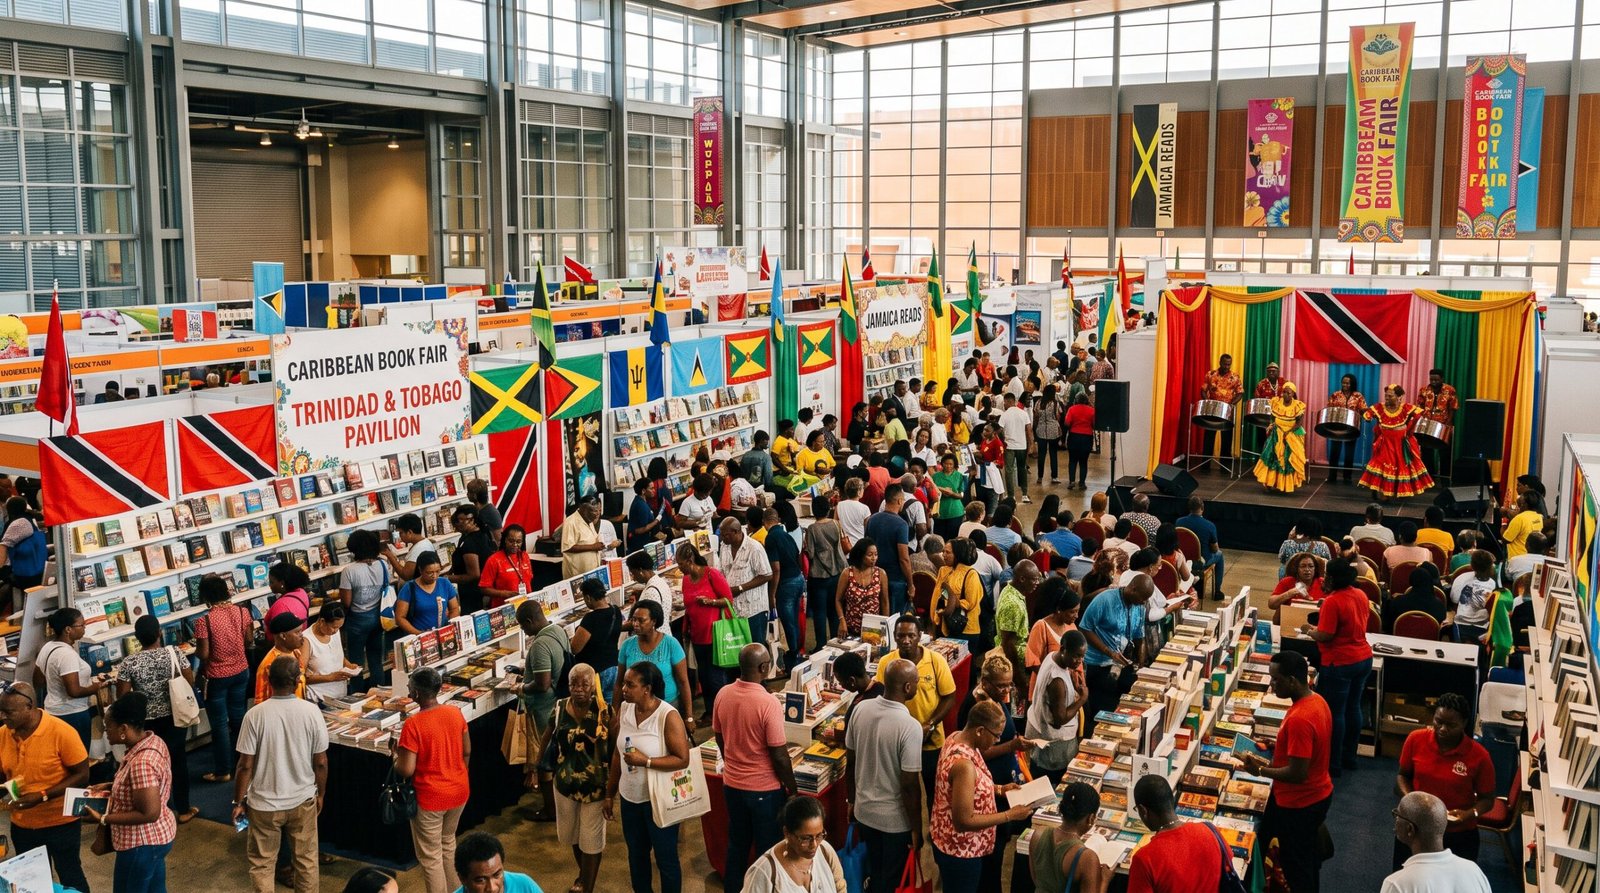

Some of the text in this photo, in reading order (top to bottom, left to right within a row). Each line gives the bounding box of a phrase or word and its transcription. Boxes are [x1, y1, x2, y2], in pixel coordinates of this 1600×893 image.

[1360, 68, 1400, 76] CARIBBEAN
[1360, 74, 1400, 83] BOOK FAIR
[1378, 96, 1399, 149] FAIR
[1160, 123, 1174, 164] READS
[1158, 166, 1174, 218] JAMAICA
[1469, 174, 1508, 187] FAIR
[866, 306, 922, 329] JAMAICA READS
[288, 344, 448, 382] CARIBBEAN BOOK FAIR
[292, 380, 462, 427] TRINIDAD & TOBAGO
[344, 414, 420, 448] PAVILION
